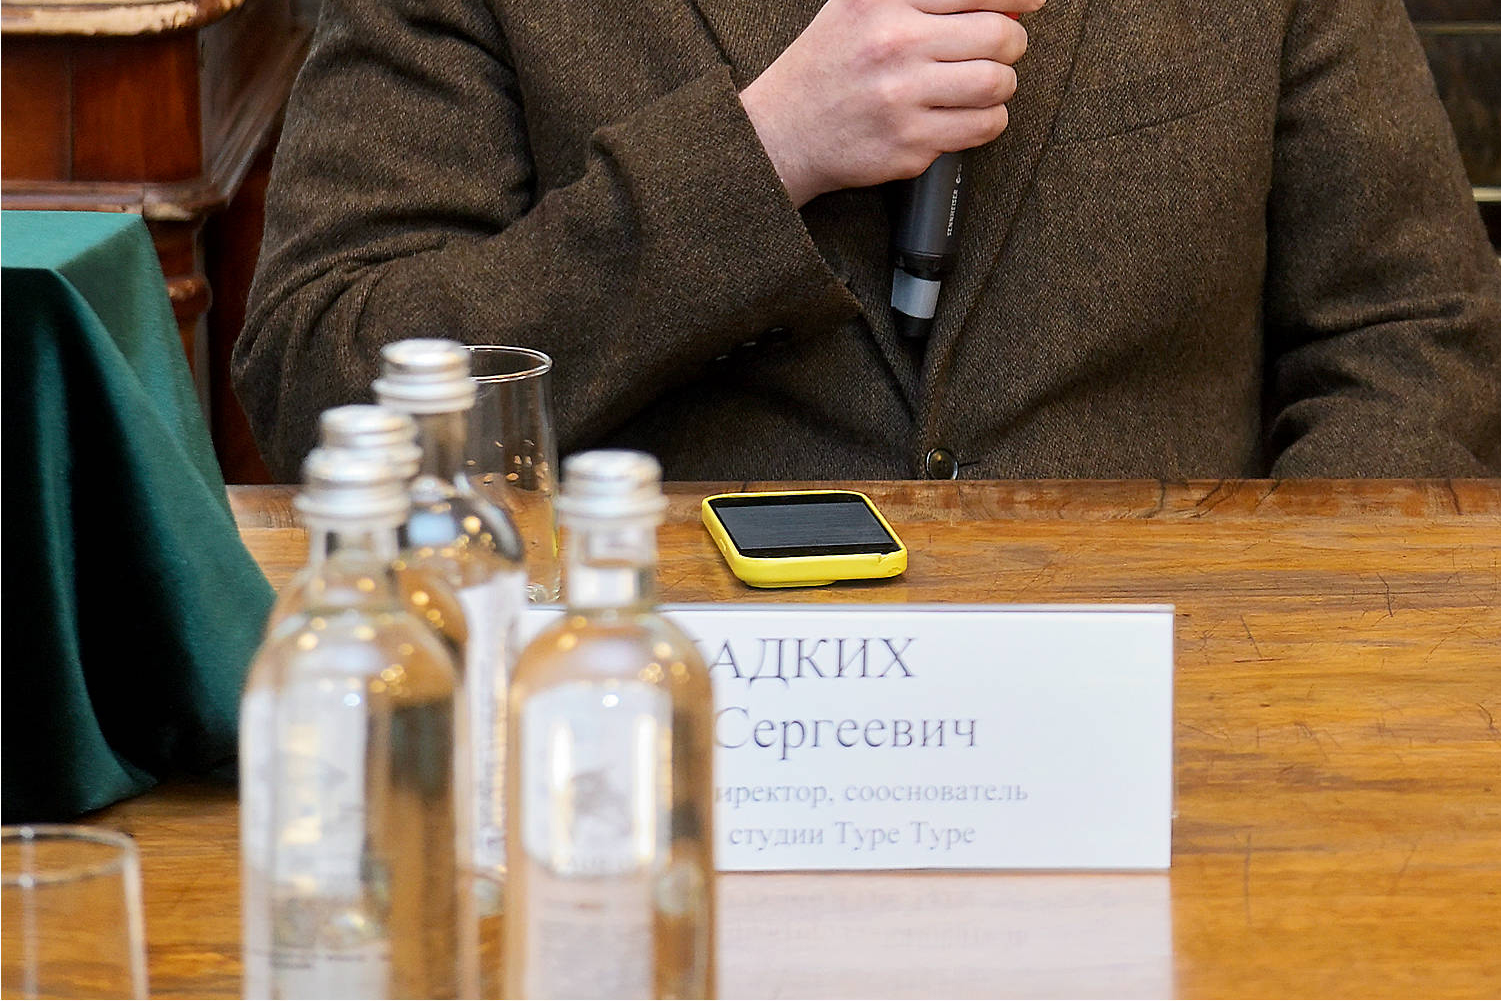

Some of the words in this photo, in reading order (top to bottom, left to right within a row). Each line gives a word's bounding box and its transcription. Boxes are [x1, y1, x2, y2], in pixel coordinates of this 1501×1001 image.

[707, 636, 916, 688] АДКИХ
[714, 706, 977, 761] Сергеевич
[717, 784, 835, 809] иректор,
[844, 783, 1029, 802] сооснователь
[729, 827, 824, 851] студии
